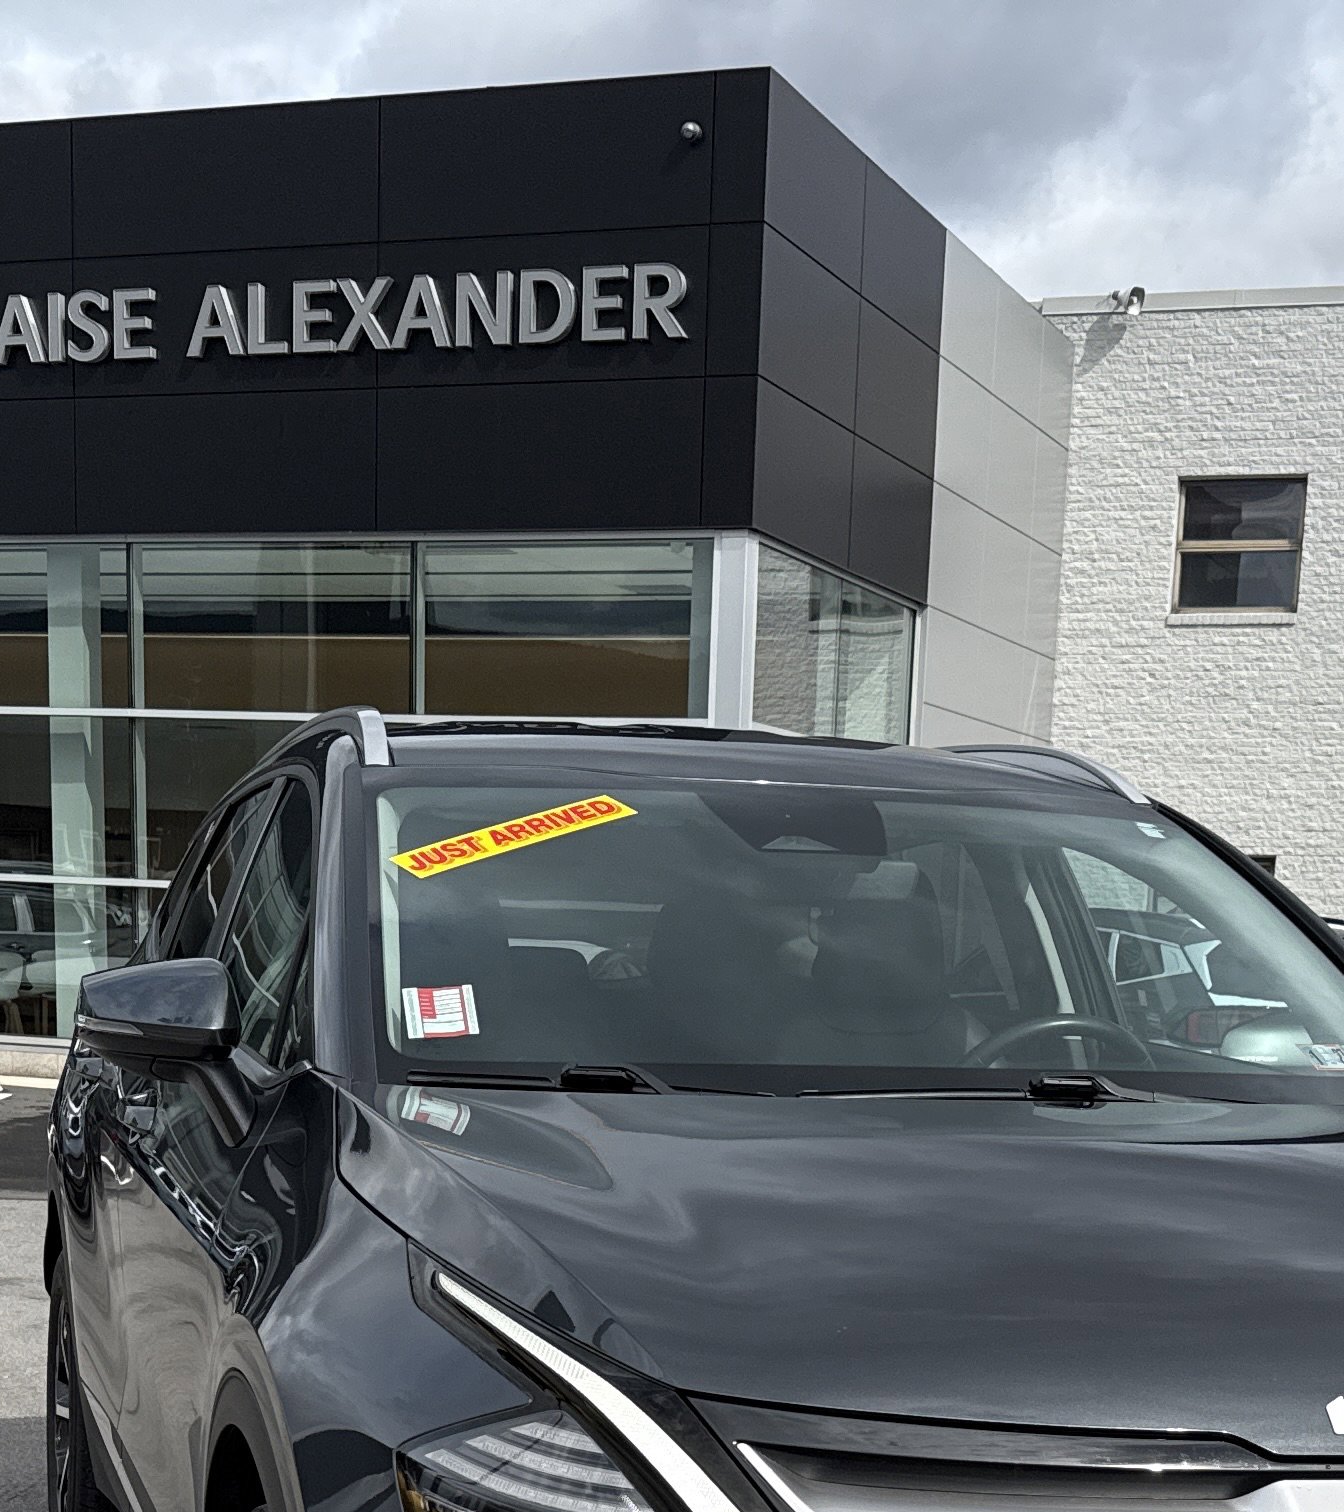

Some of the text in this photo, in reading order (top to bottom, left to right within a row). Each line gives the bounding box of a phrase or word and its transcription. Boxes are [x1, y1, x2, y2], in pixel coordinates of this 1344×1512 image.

[186, 262, 690, 358] ALEXANDER
[409, 800, 623, 873] JUST ARRIVED
